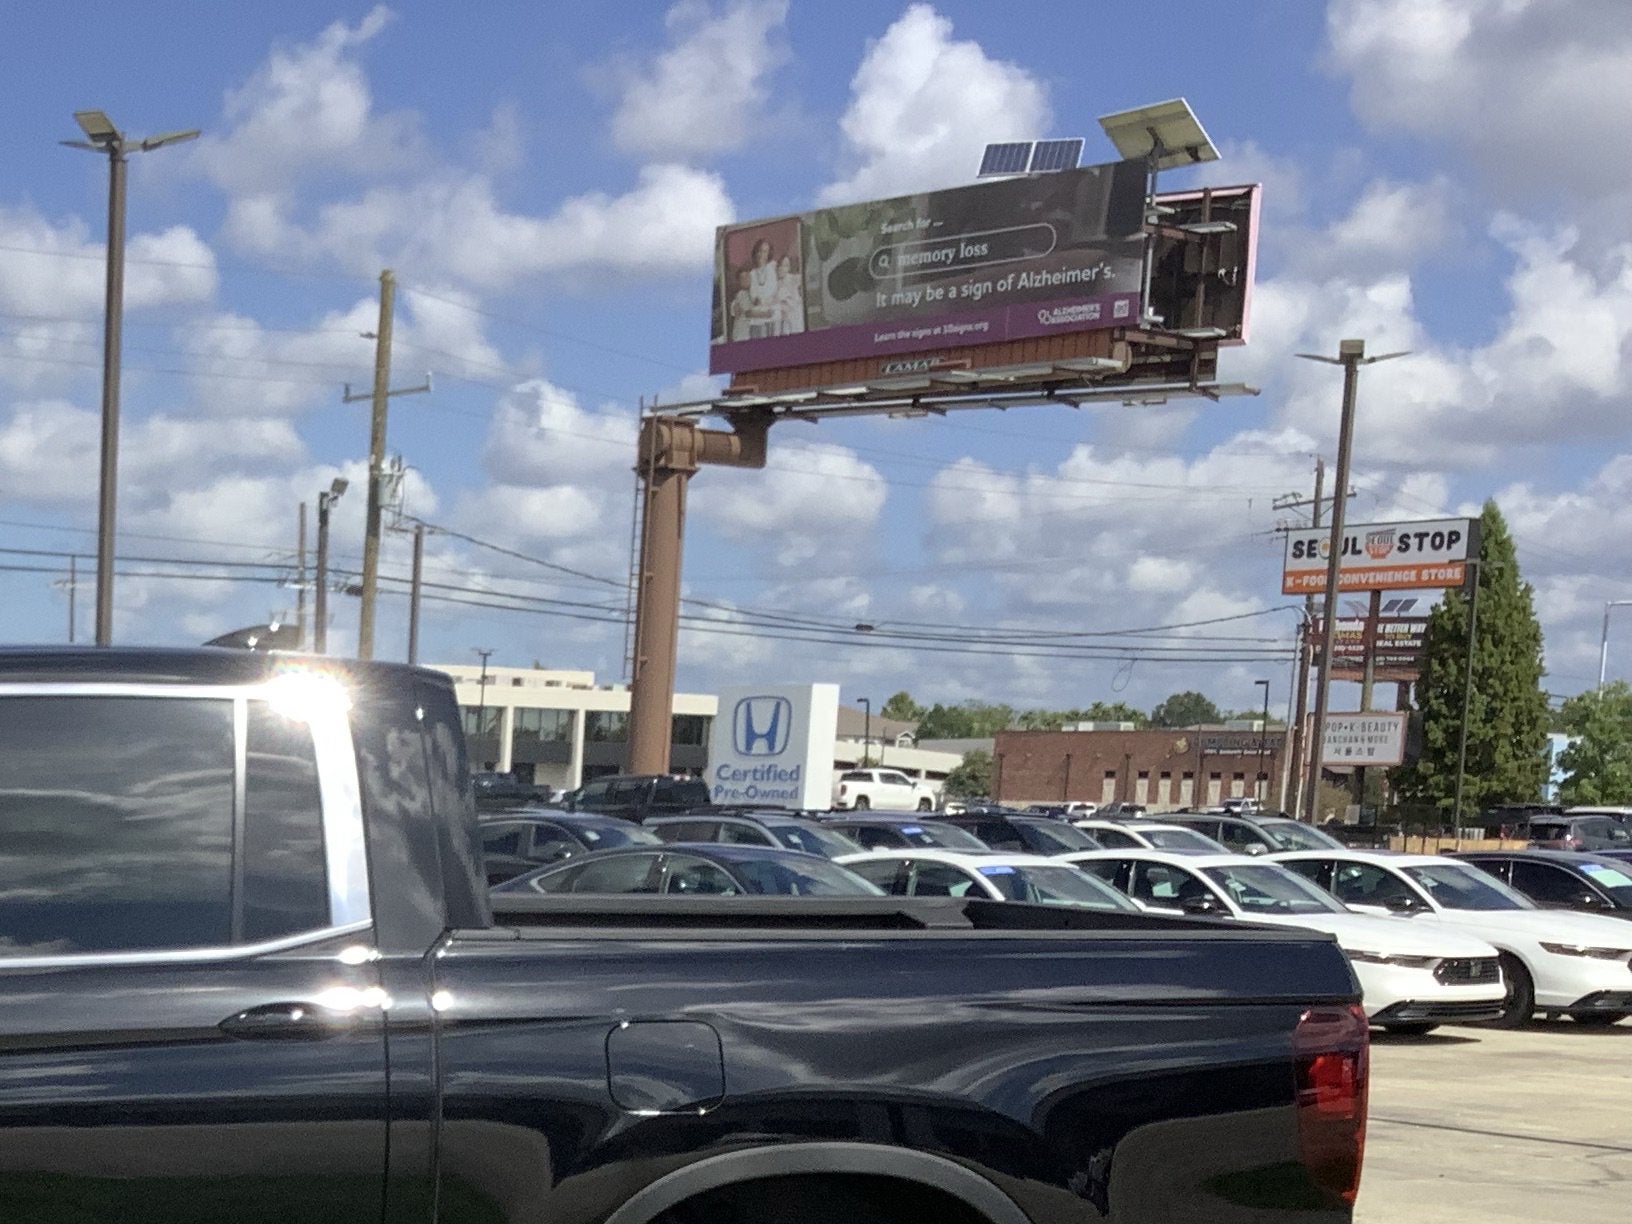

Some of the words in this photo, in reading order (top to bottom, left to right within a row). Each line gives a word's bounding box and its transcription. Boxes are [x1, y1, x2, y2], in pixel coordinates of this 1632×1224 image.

[898, 247, 956, 266] memory
[960, 242, 990, 259] loss
[876, 292, 887, 308] It
[891, 289, 922, 308] may
[926, 284, 944, 300] be
[948, 287, 957, 298] a
[961, 278, 993, 300] sign
[997, 273, 1016, 292] of
[1017, 262, 1117, 290] Alzheimer's.
[1397, 530, 1462, 553] STOP
[1286, 575, 1329, 588] K-FOO
[1421, 566, 1462, 581] STORE
[716, 764, 801, 782] Certified
[714, 784, 799, 800] Pre-Owned
